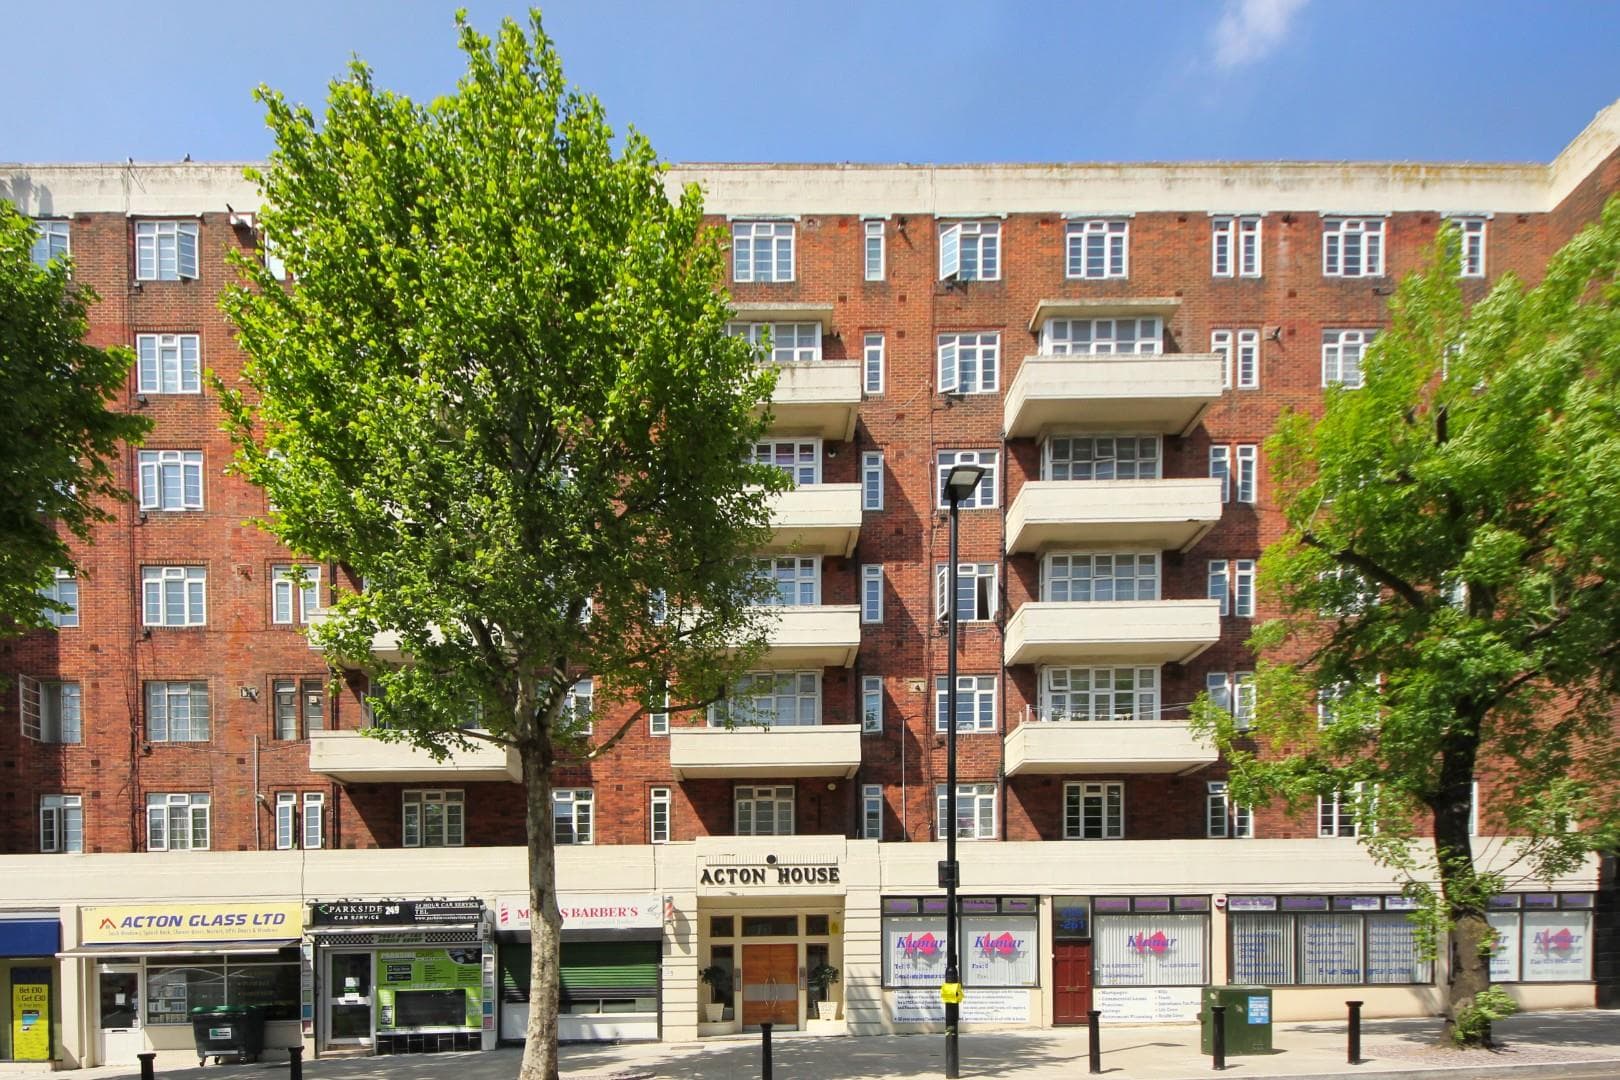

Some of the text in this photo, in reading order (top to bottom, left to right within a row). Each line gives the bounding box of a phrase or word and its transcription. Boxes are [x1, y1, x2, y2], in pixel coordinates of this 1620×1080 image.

[700, 867, 840, 885] ACTON HOUSE
[329, 905, 384, 913] PARKSIDE
[571, 906, 639, 918] BARBER'S
[121, 913, 286, 928] ACTON GLASS LTD
[896, 936, 946, 949] Kumar
[974, 936, 1025, 949] Kumar
